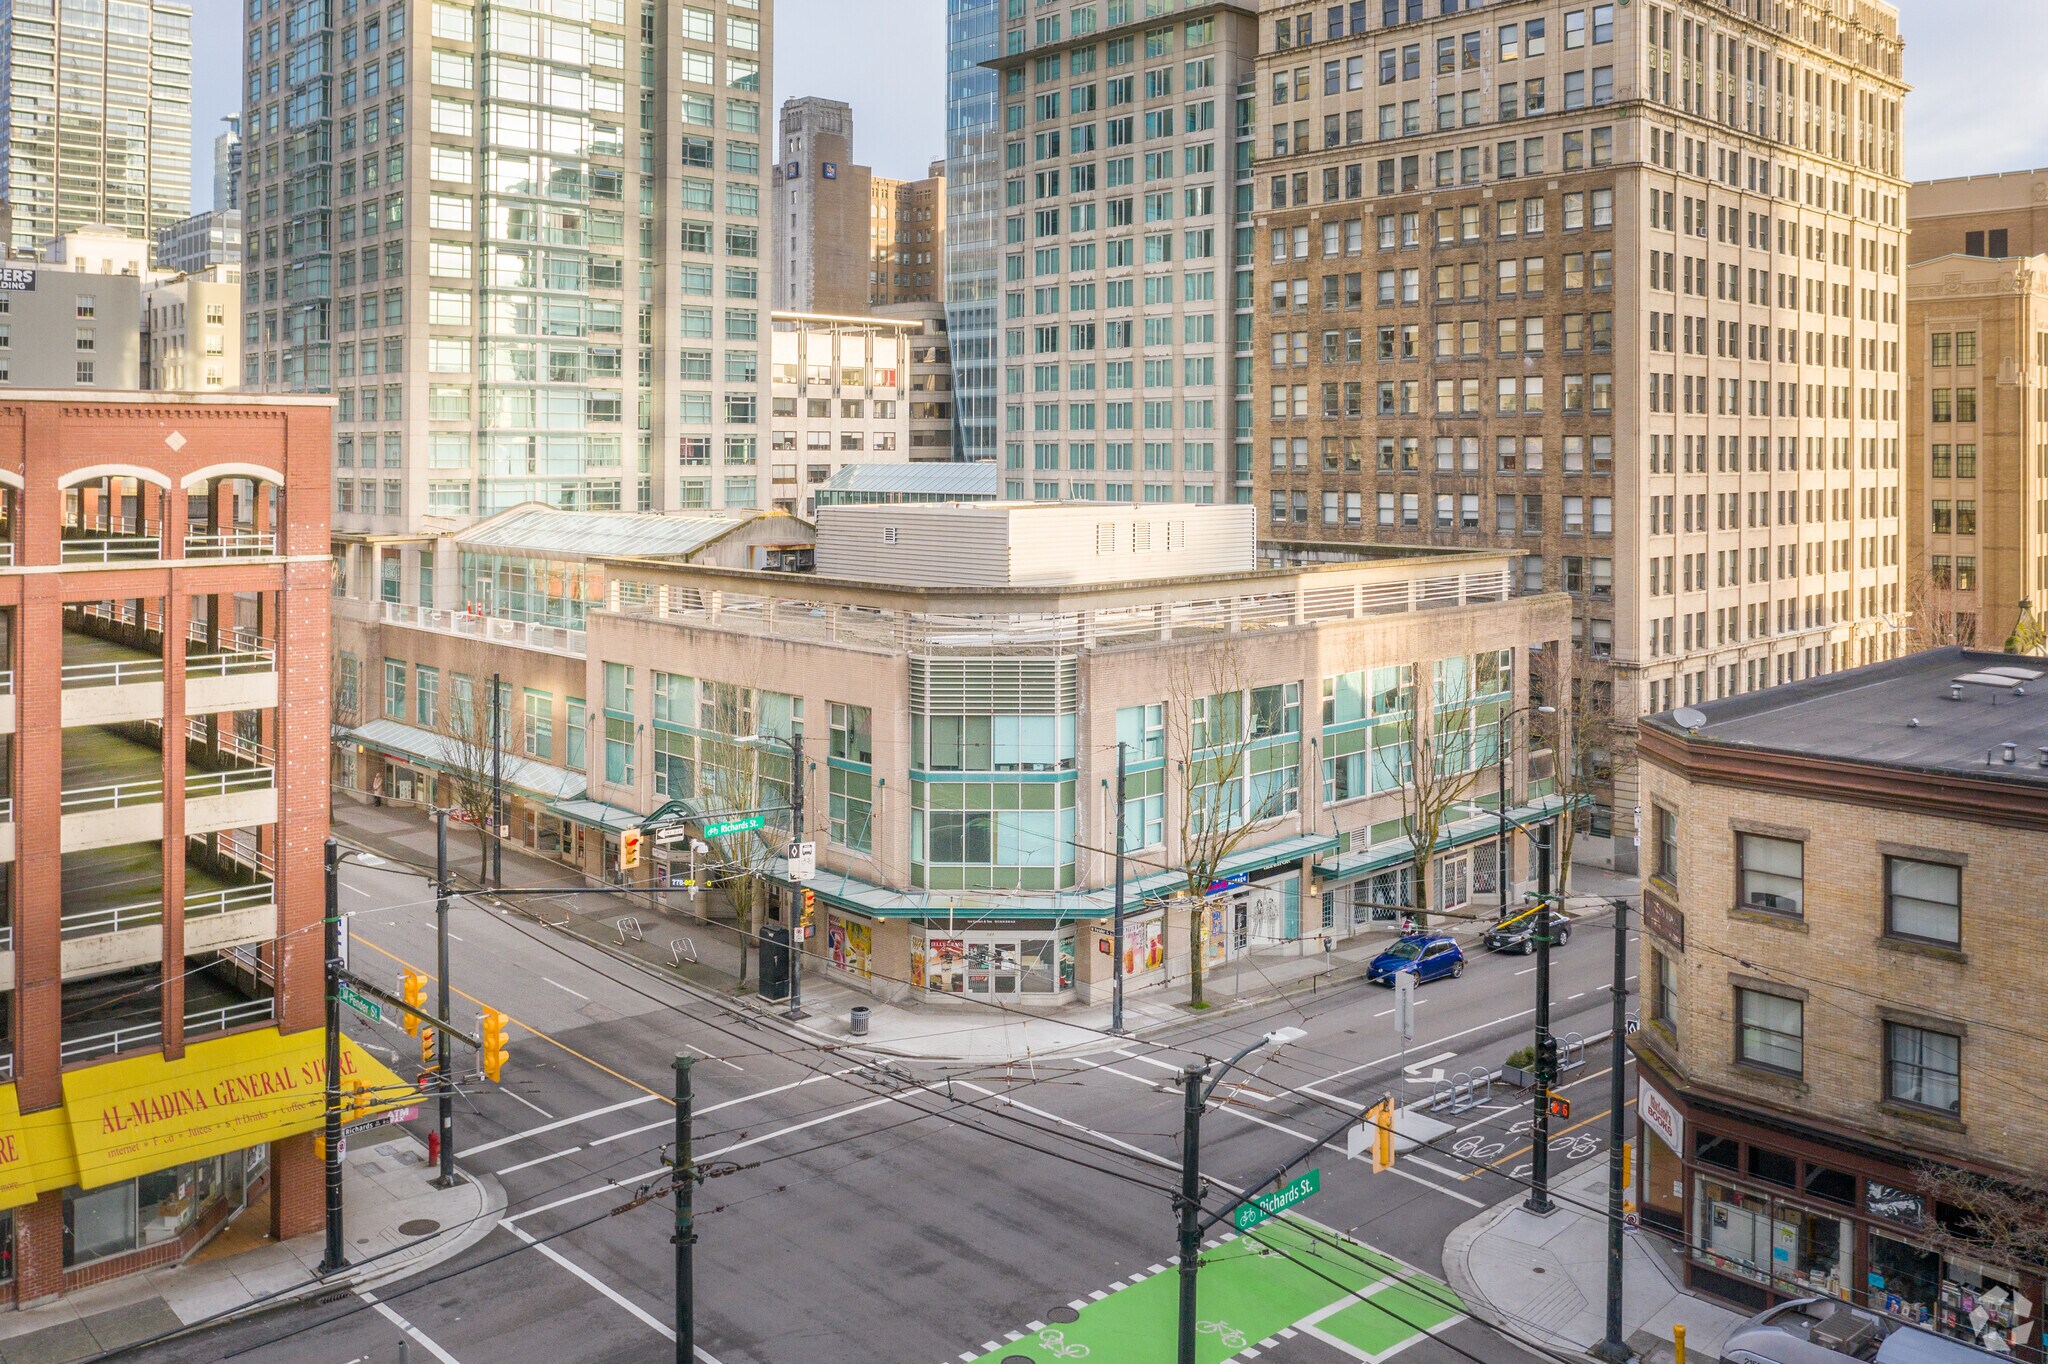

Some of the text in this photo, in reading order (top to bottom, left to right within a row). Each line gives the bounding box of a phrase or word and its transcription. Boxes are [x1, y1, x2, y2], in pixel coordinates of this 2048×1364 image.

[0, 269, 33, 283] ERS
[721, 819, 759, 833] Richards St.
[349, 993, 369, 1014] Pender
[102, 1087, 208, 1135] AL-MADINA
[213, 1066, 298, 1107] GENERAL
[387, 1107, 409, 1119] ATM
[1648, 1105, 1673, 1138] BOOKS
[345, 1122, 373, 1135] Richards
[1260, 1179, 1313, 1217] Richards St.
